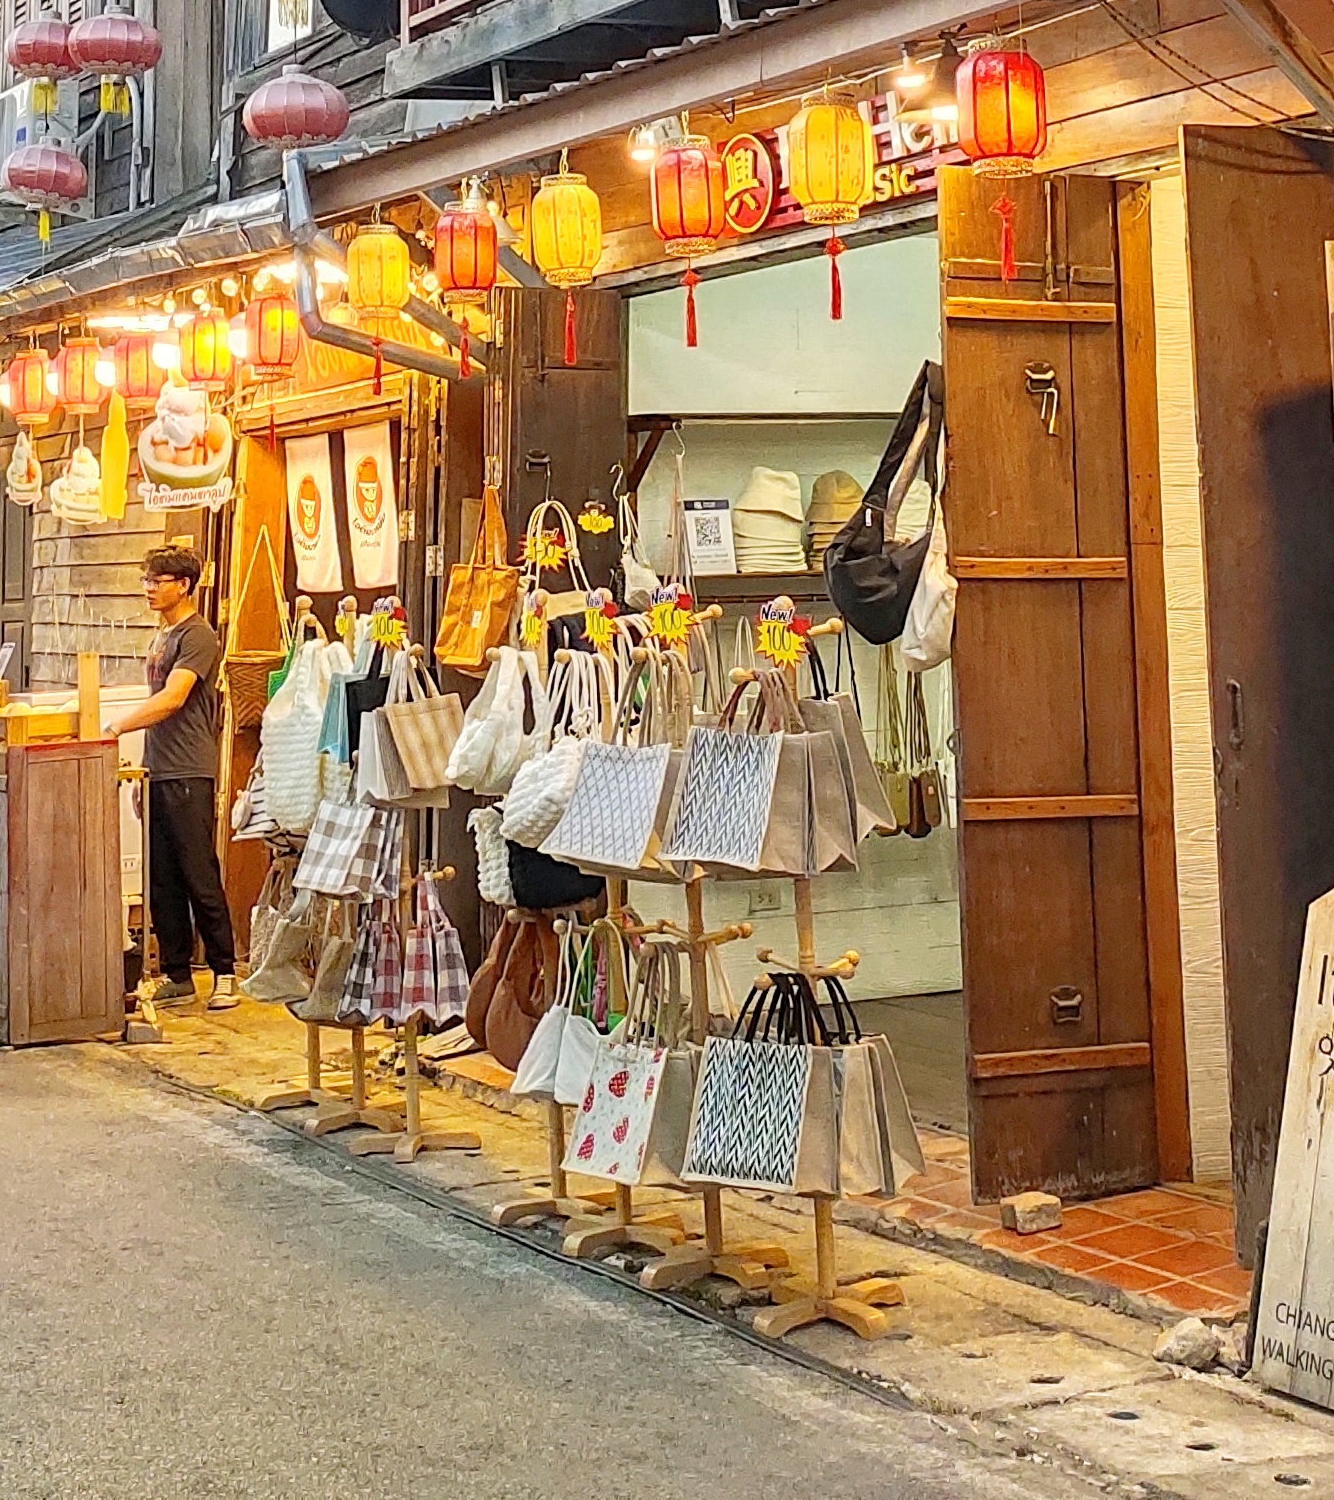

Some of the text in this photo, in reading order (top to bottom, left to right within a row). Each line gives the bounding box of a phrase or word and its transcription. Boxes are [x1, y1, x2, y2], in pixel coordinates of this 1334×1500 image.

[725, 147, 759, 216] 興
[651, 587, 678, 605] New!
[589, 610, 605, 635] 100
[659, 608, 682, 632] 100
[762, 603, 794, 621] New!
[376, 616, 394, 636] 100
[767, 625, 791, 652] 100
[1261, 1333, 1334, 1381] WALKING
